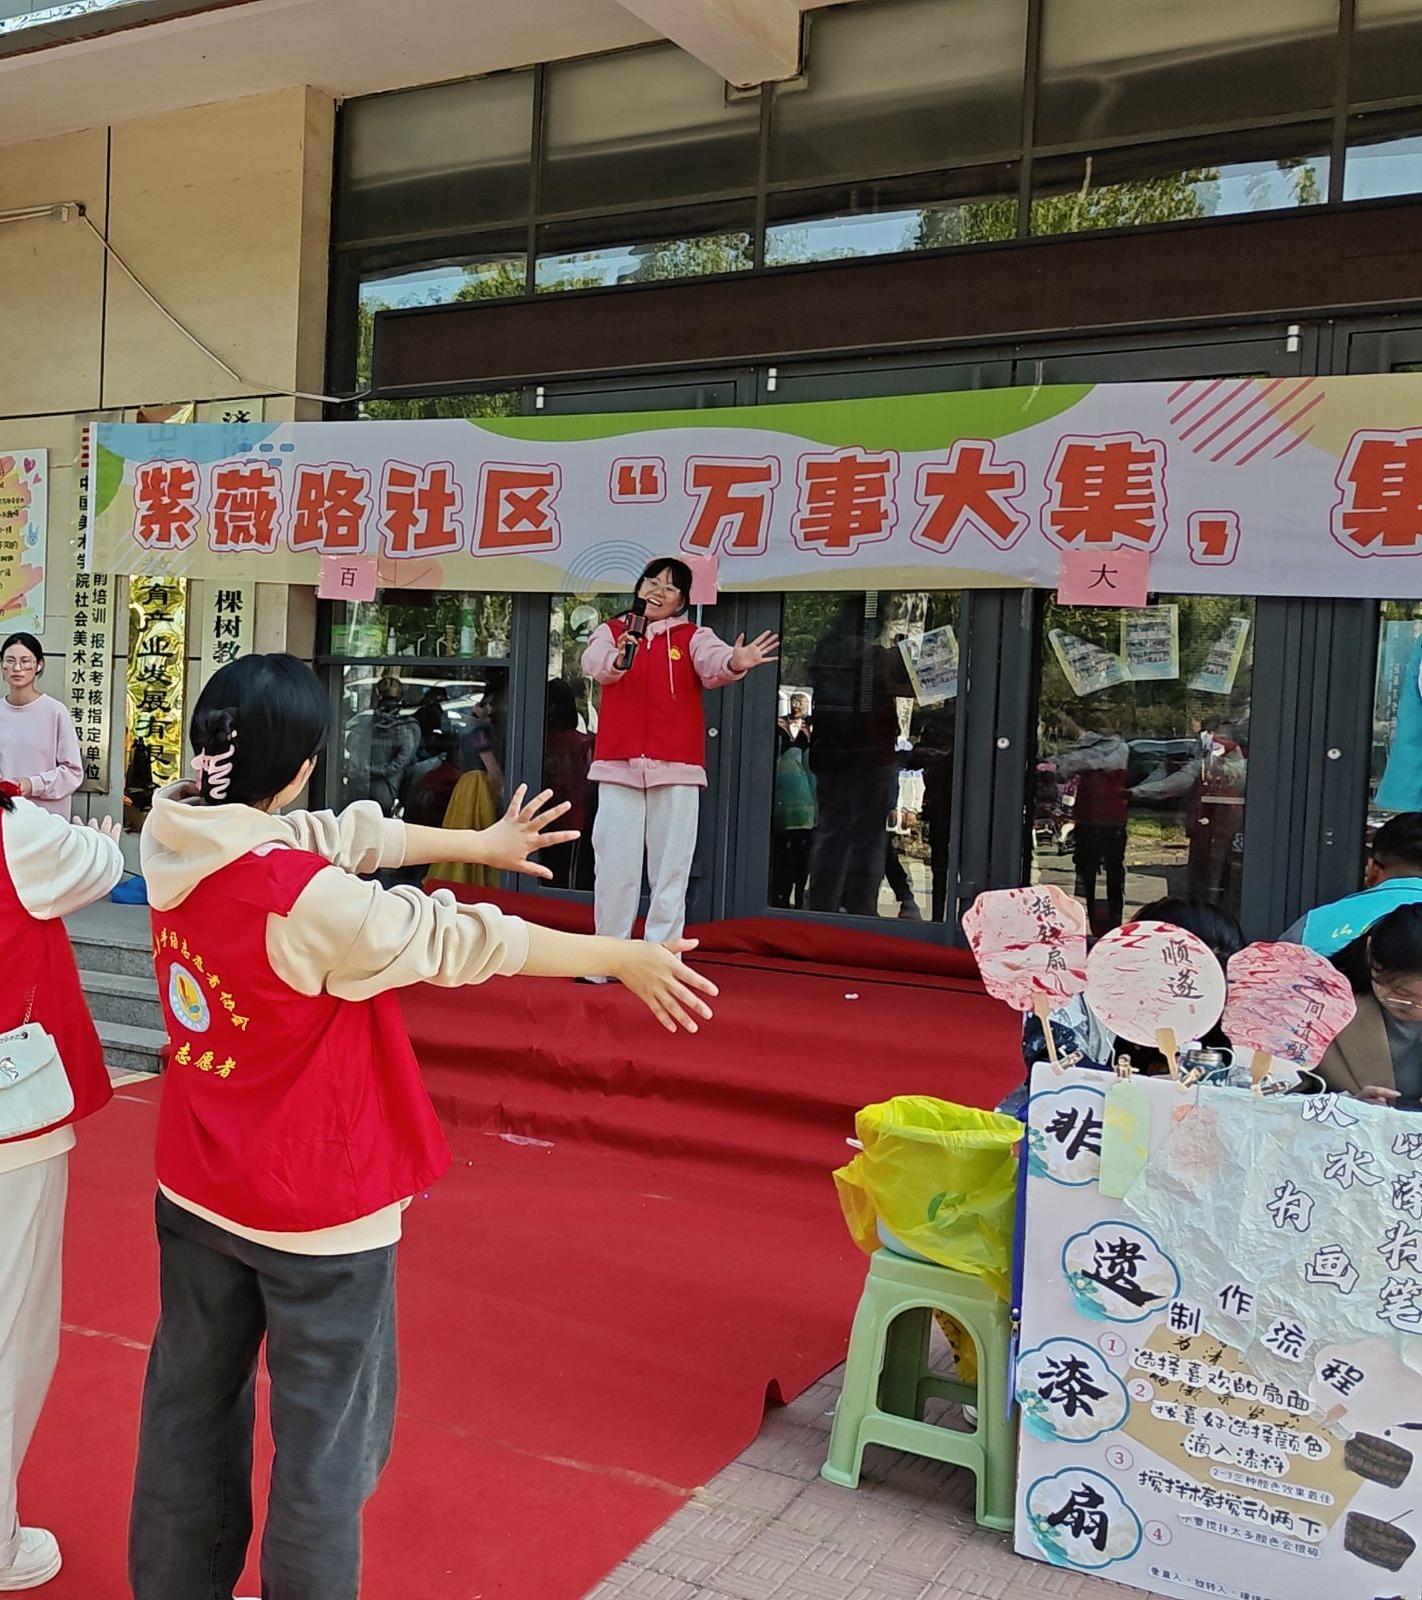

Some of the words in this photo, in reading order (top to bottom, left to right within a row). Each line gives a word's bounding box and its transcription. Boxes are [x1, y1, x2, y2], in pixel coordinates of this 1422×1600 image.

[340, 566, 356, 588] 百
[1089, 563, 1119, 590] 大
[136, 583, 174, 782] 育产业发展有限
[1032, 895, 1067, 973] 摇钱扇
[1162, 939, 1205, 999] 顺遂
[1134, 1348, 1310, 1411] 选择喜欢的扇面
